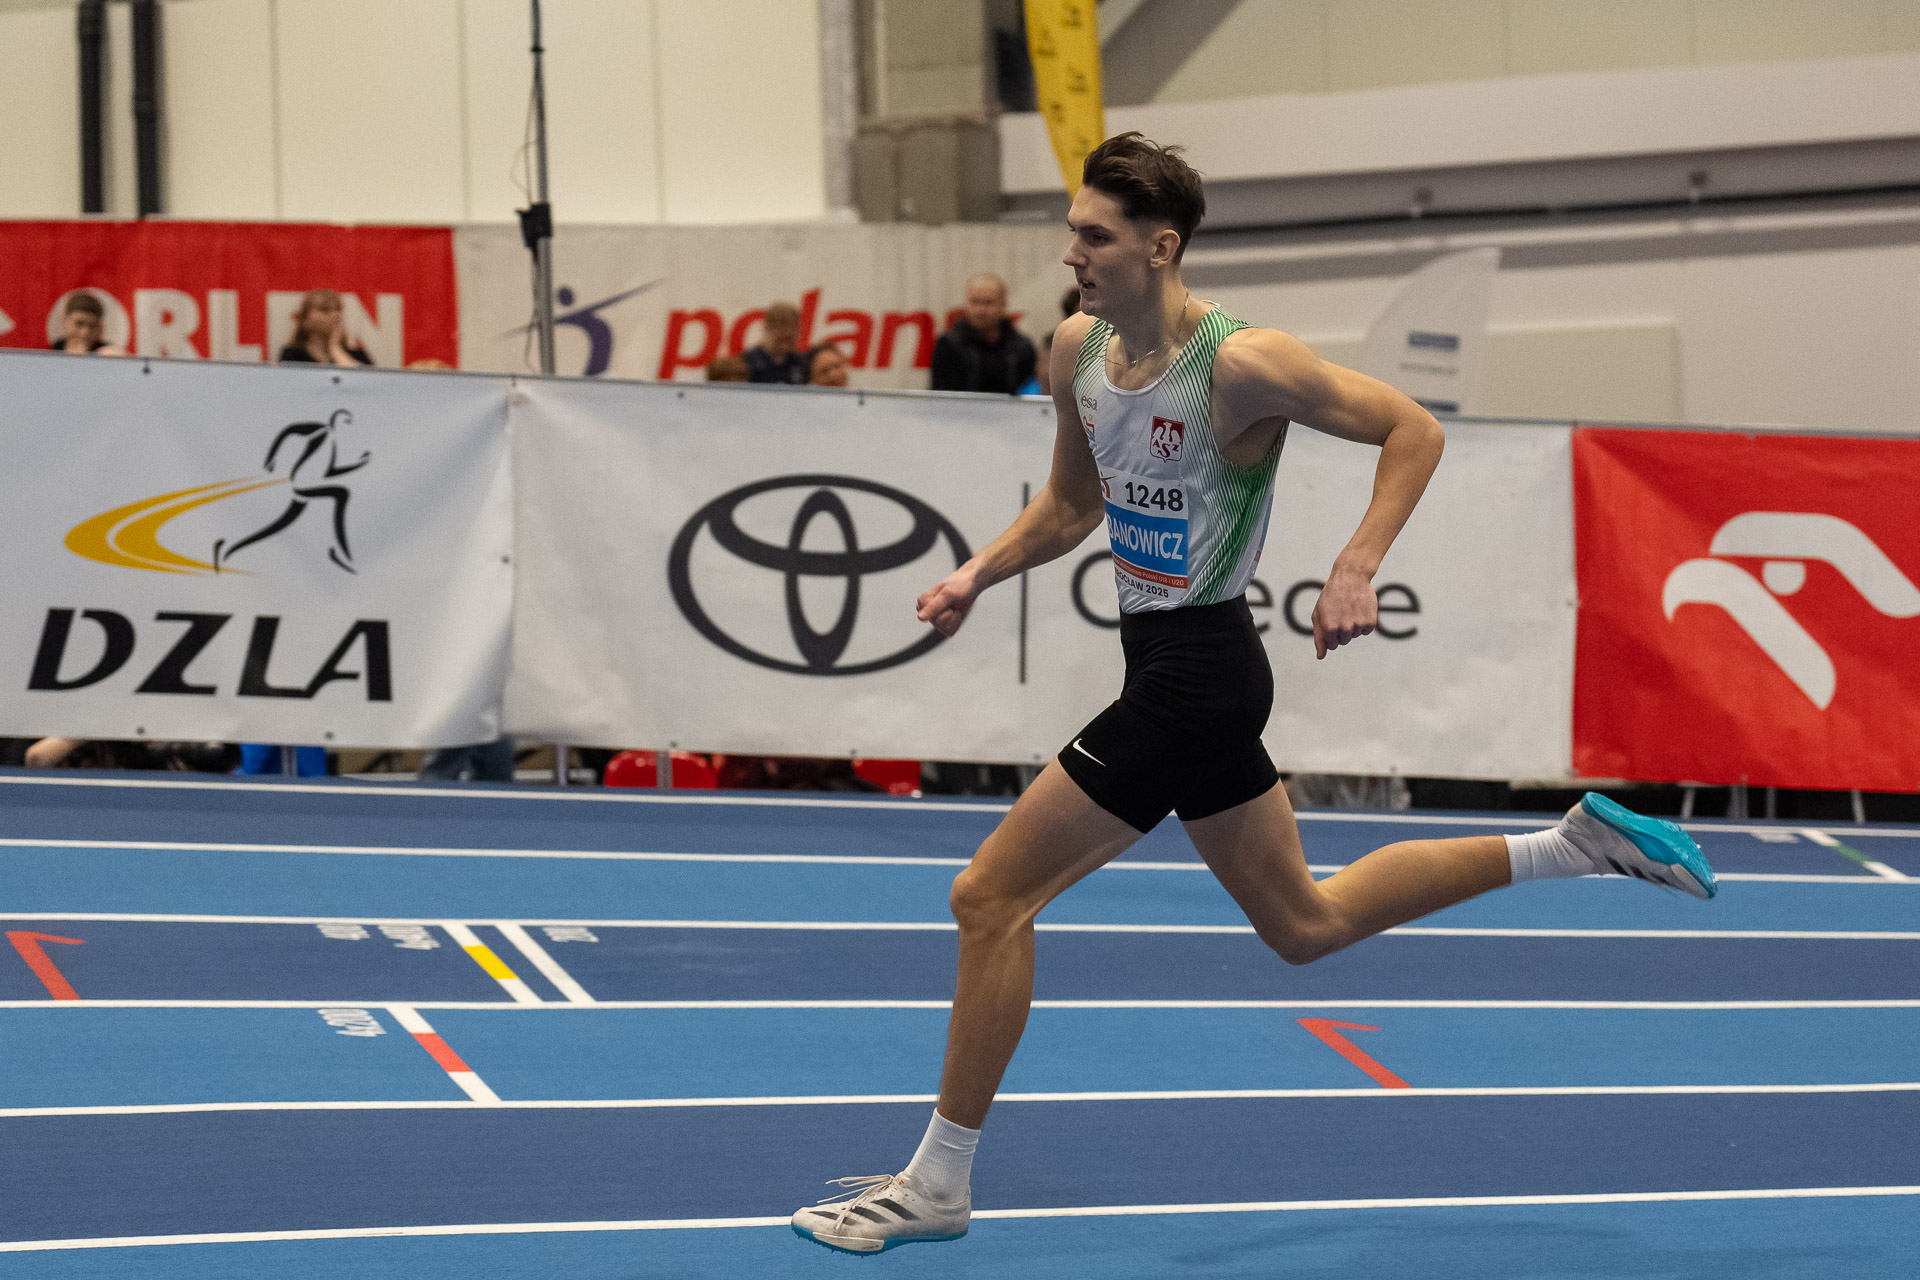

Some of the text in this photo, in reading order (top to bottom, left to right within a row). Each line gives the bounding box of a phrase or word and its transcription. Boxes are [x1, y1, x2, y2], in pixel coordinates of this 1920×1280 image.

[1081, 395, 1097, 410] esa
[1124, 481, 1184, 512] 1248
[1145, 584, 1169, 598] 2025
[27, 608, 393, 702] DZLA
